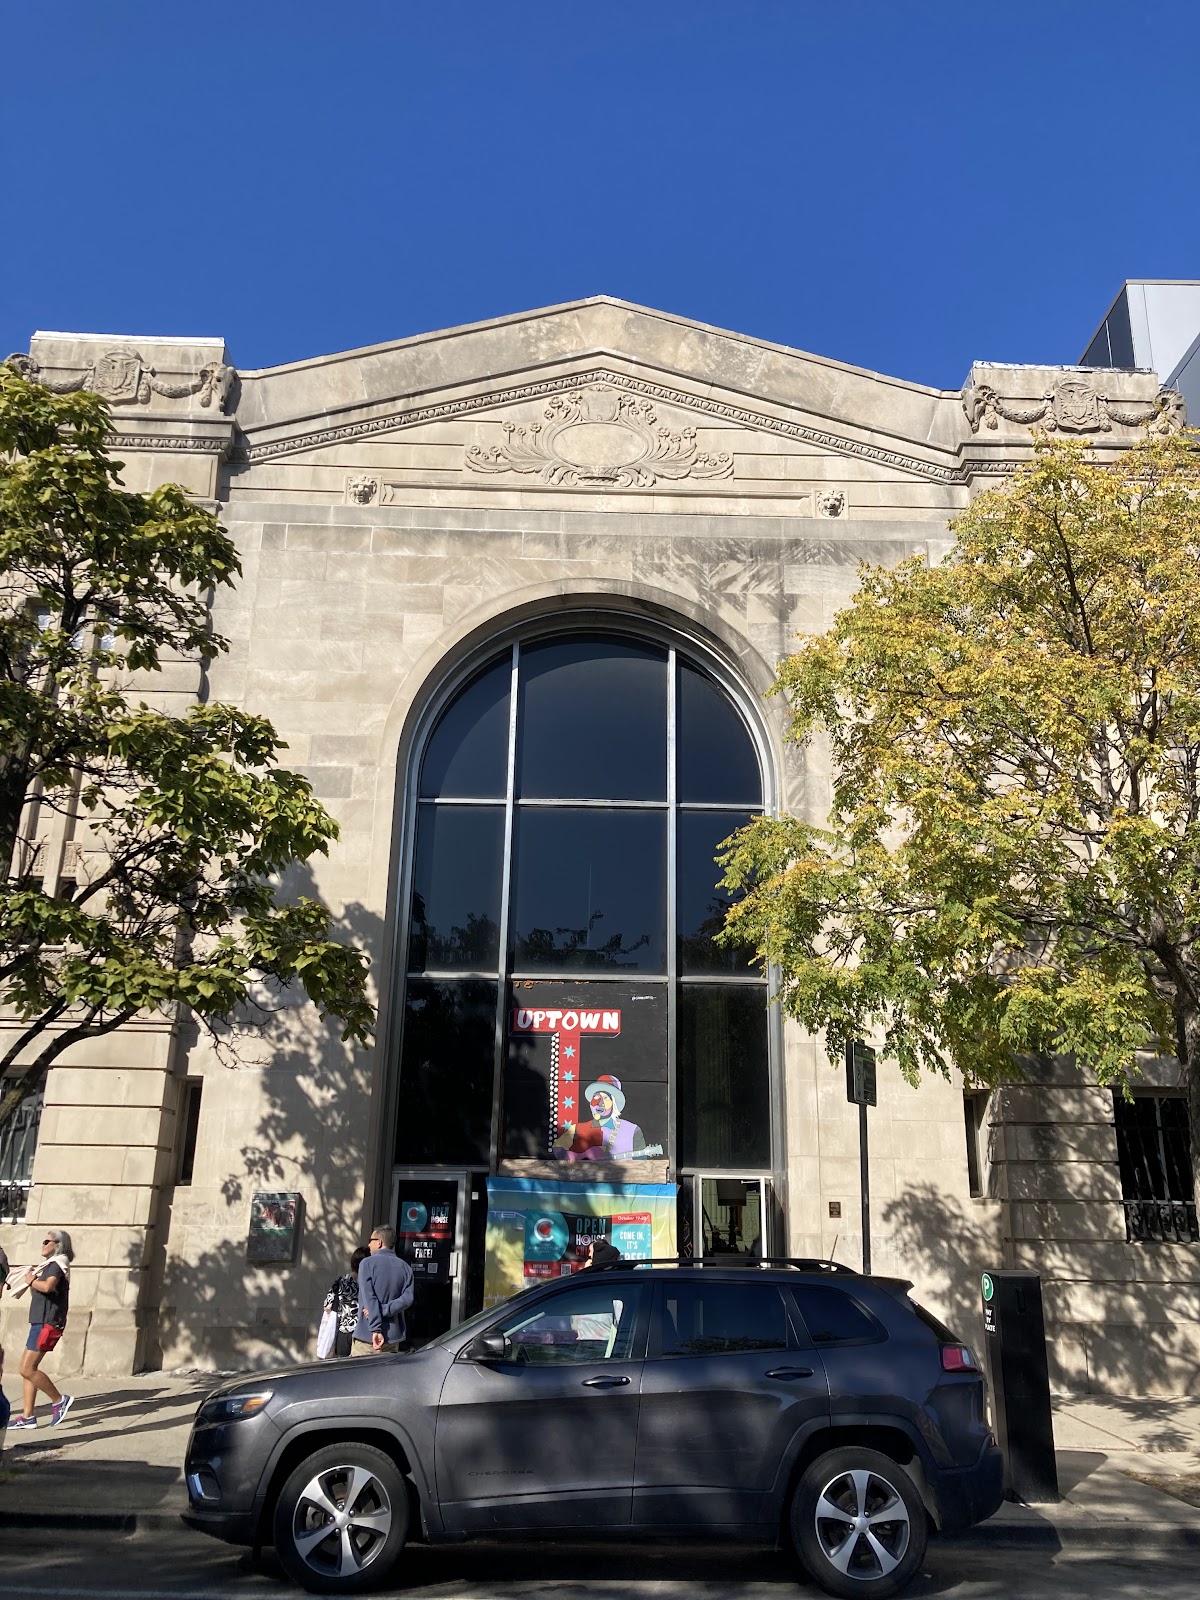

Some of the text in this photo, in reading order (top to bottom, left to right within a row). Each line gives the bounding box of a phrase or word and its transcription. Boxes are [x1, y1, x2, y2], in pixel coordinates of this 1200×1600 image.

[517, 1009, 619, 1031] UPTOWN
[431, 1206, 449, 1216] OPEN
[576, 1218, 606, 1234] OPEN
[619, 1231, 645, 1241] COME IN,
[626, 1241, 638, 1250] IT'S
[414, 1248, 433, 1259] FREE!
